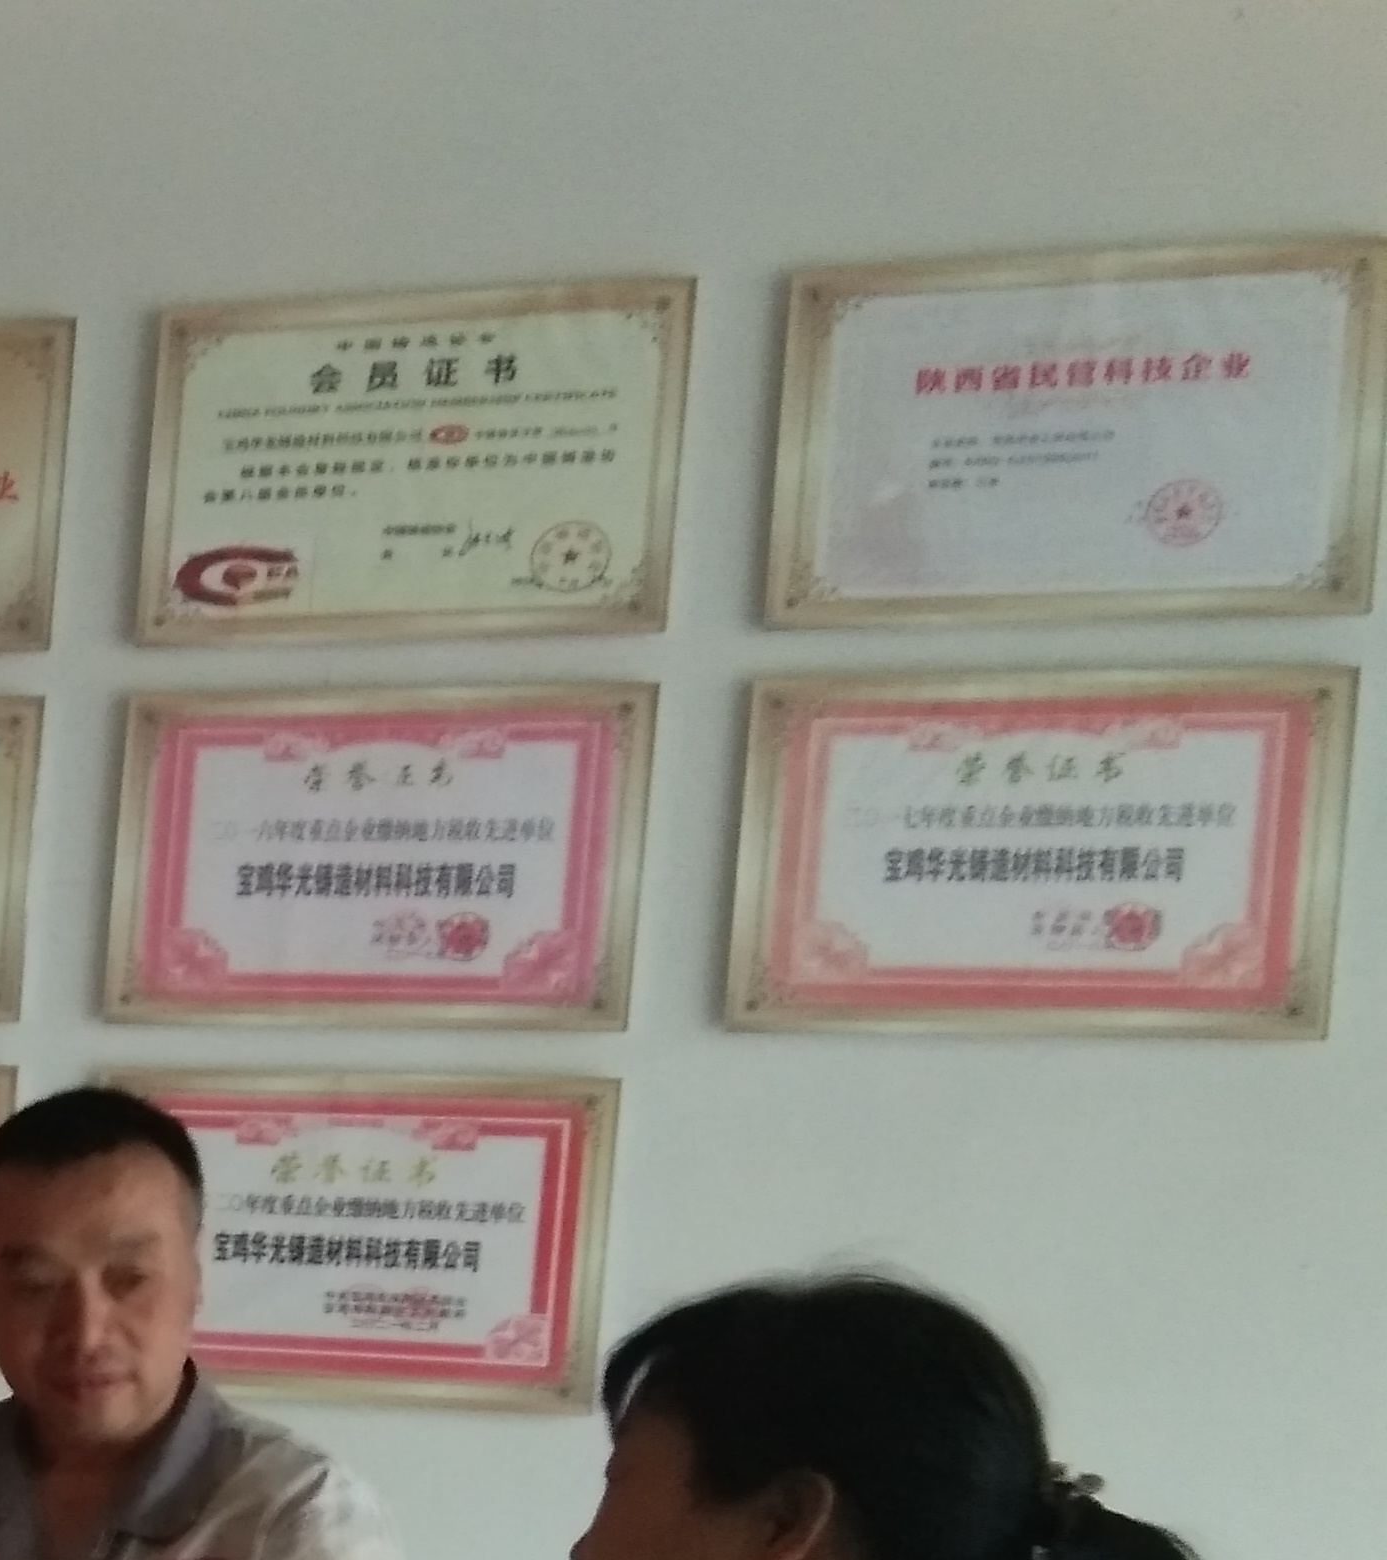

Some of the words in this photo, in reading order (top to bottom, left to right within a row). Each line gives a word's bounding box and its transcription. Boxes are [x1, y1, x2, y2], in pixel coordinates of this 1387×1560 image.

[310, 353, 519, 393] 会员证书
[914, 352, 1251, 394] 陕西省民营科技企业
[955, 749, 1130, 786] 荣誉证书
[235, 861, 518, 899] 宝鸡华光铸造材料科技有限公司
[882, 845, 1186, 884] 宝鸡华光铸造材料科技有限公司
[270, 1149, 438, 1186] 荣誉证书
[212, 1229, 483, 1274] 宝鸡华光铸造材料科技有限公司
